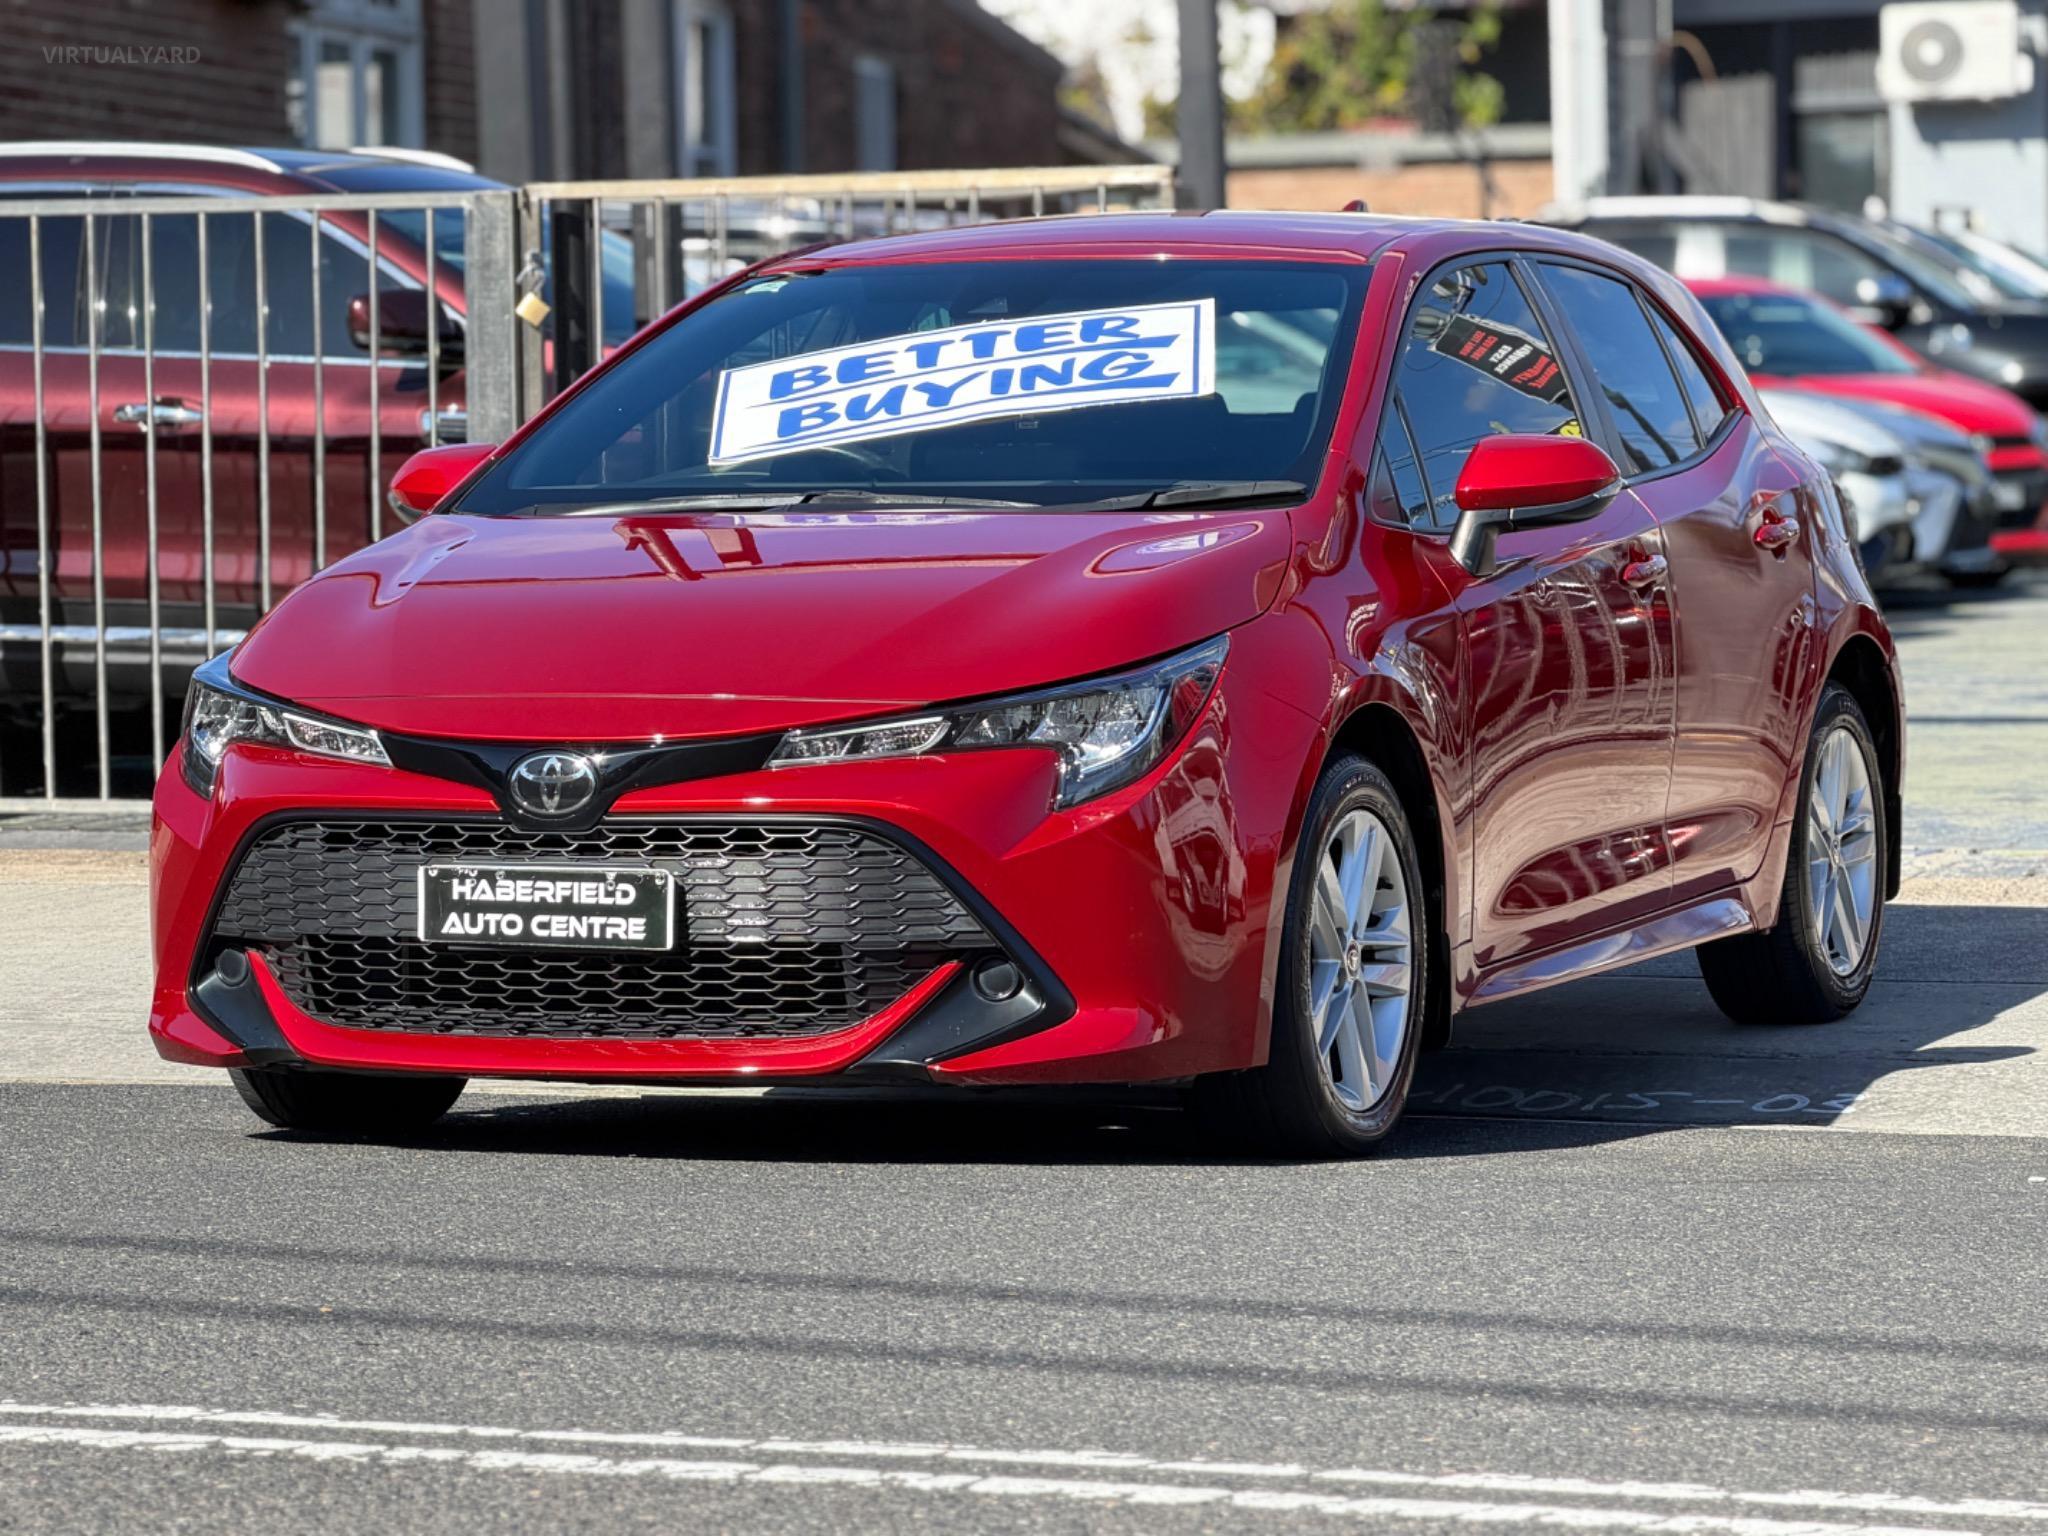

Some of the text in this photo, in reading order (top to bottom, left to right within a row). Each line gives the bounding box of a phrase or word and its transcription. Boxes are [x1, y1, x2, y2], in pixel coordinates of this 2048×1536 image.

[769, 316, 1142, 400] BETTER
[777, 351, 1156, 438] BUYING
[452, 879, 636, 905] HABERFIELD
[441, 912, 648, 941] AUTO CENTRE
